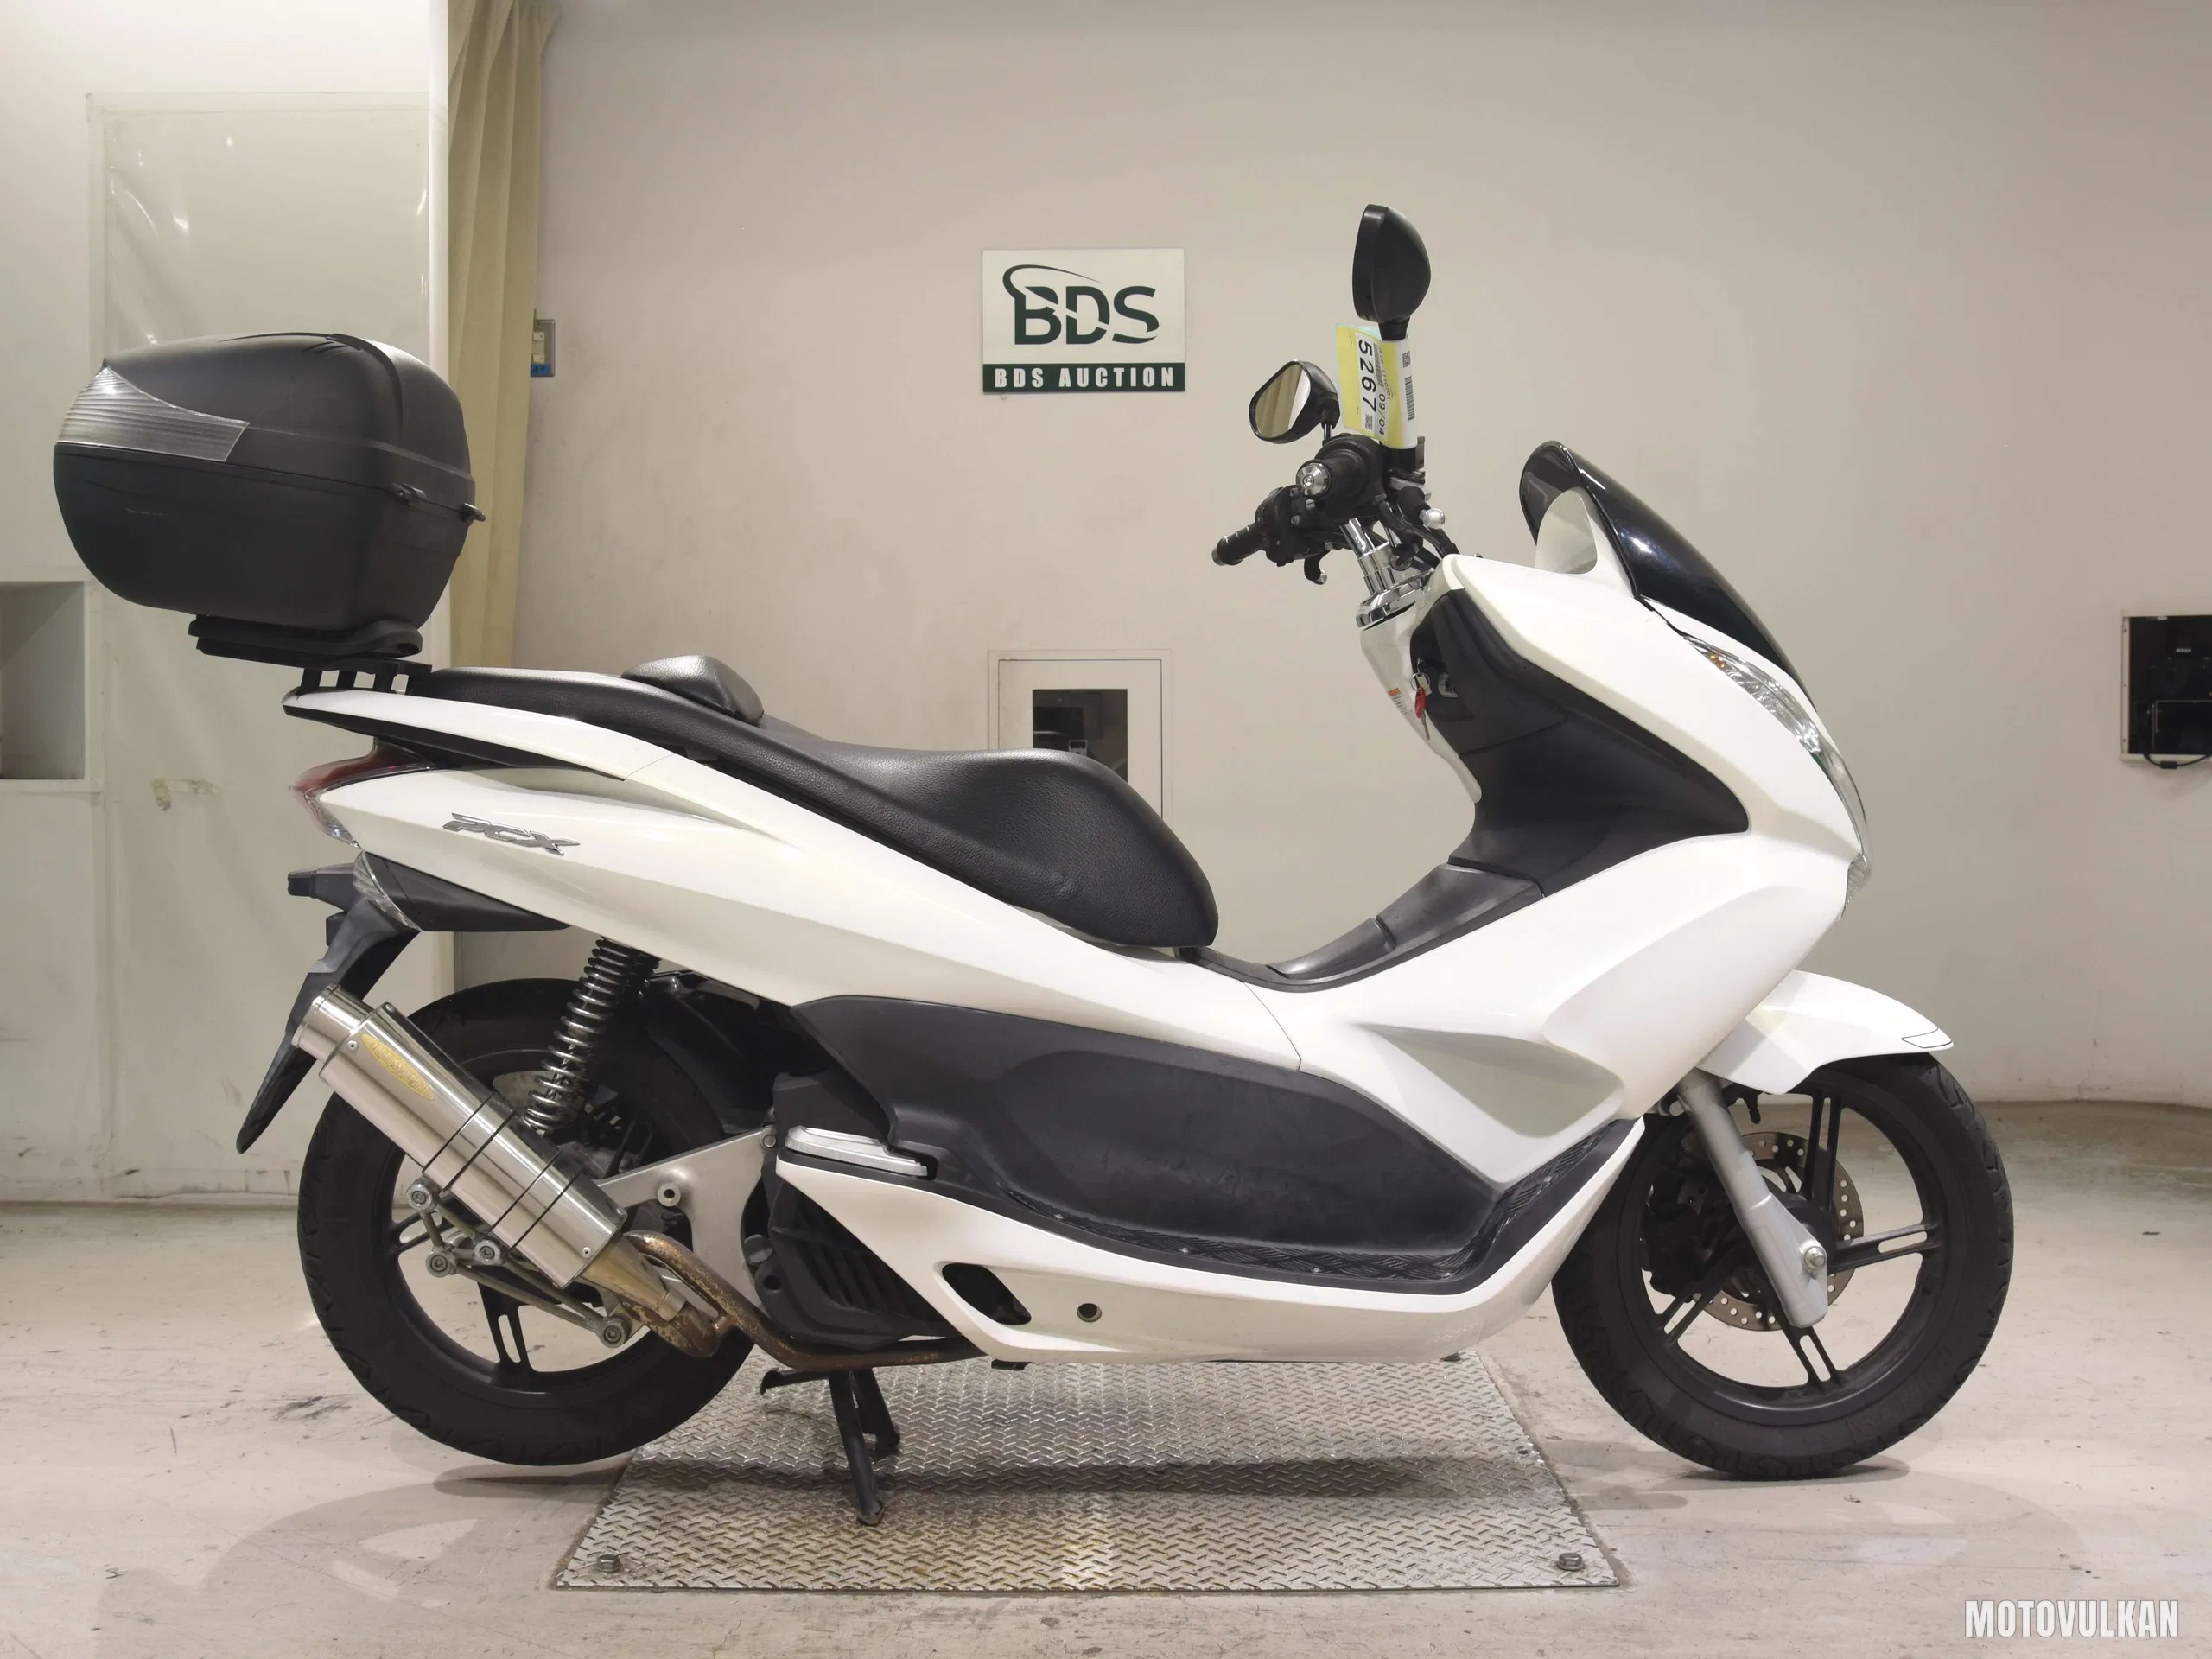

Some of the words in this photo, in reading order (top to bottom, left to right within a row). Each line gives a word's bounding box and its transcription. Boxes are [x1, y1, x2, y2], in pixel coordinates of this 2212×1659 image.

[1003, 264, 1160, 345] BDS
[995, 367, 1044, 388] BDS
[1058, 367, 1174, 387] AUCTION
[1358, 339, 1377, 413] 5267
[442, 813, 581, 855] PCX
